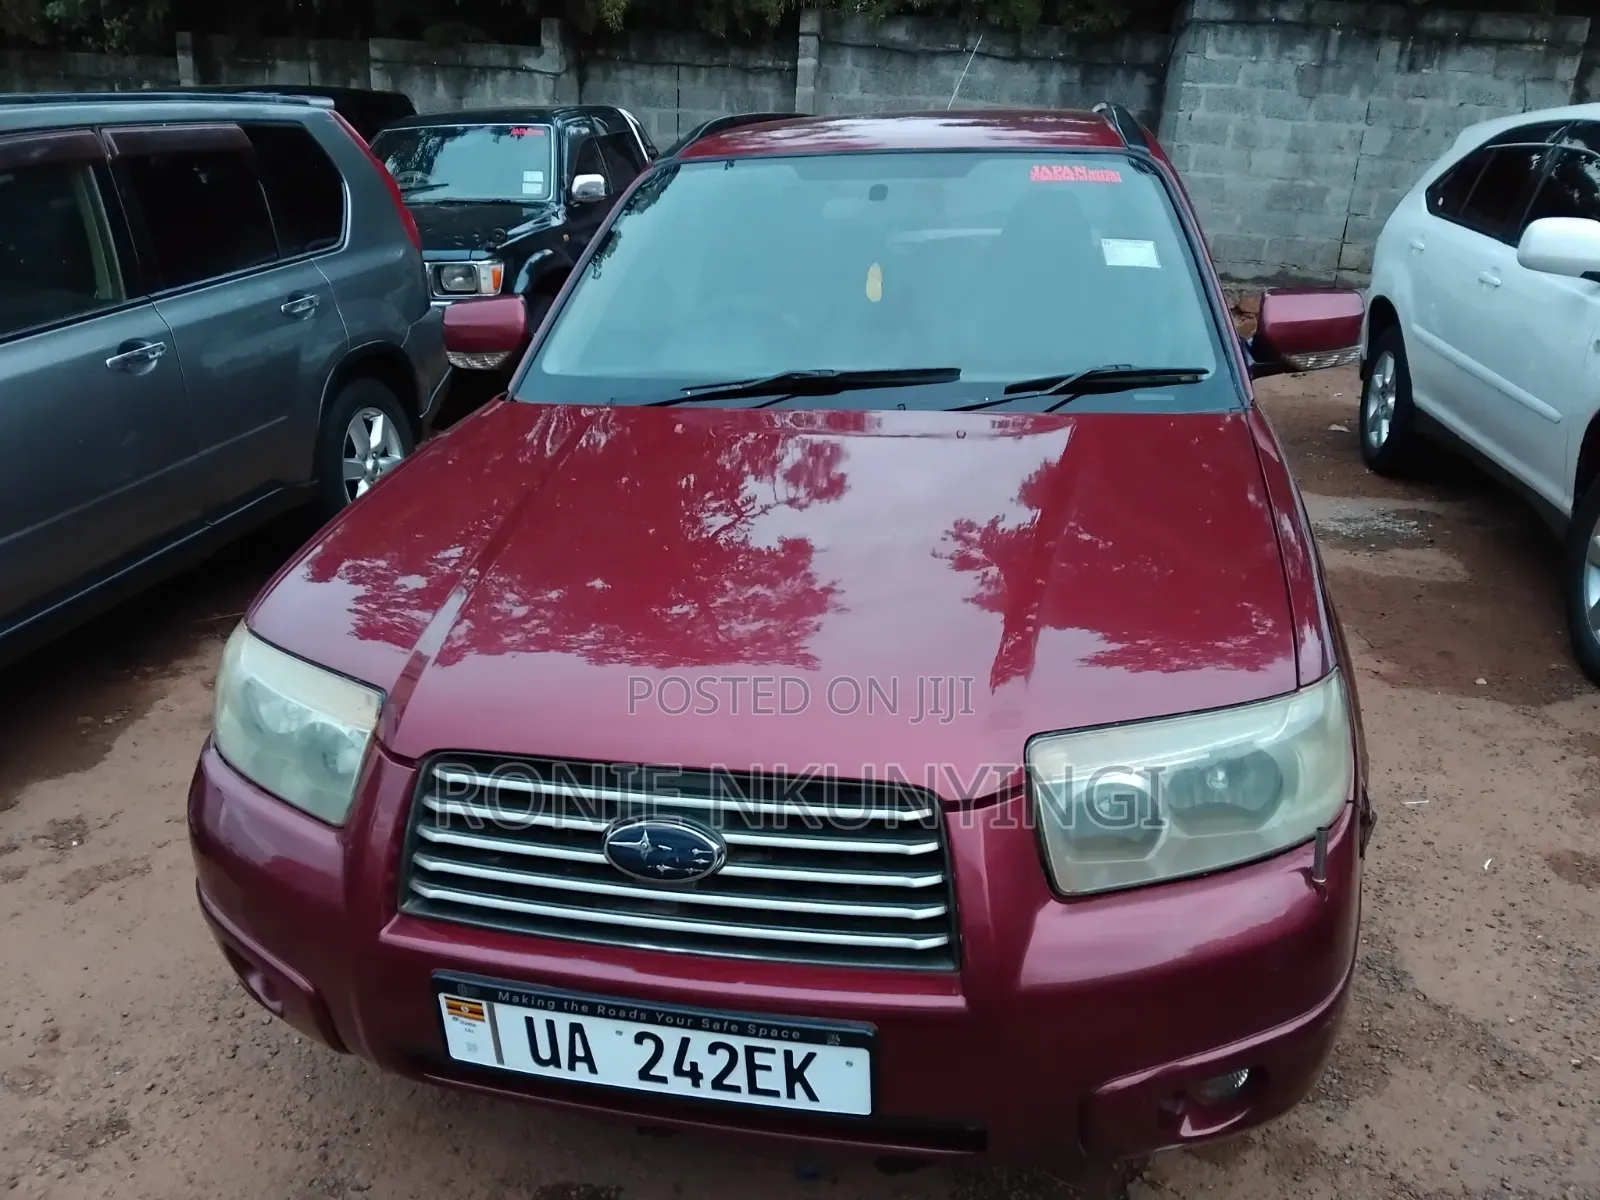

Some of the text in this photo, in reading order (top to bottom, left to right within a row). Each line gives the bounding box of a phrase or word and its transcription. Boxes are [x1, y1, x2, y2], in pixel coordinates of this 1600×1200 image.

[1031, 165, 1087, 177] JAPAN
[498, 991, 800, 1040] Making the Roads Your Safe Space
[524, 1015, 820, 1102] UA 242EK
